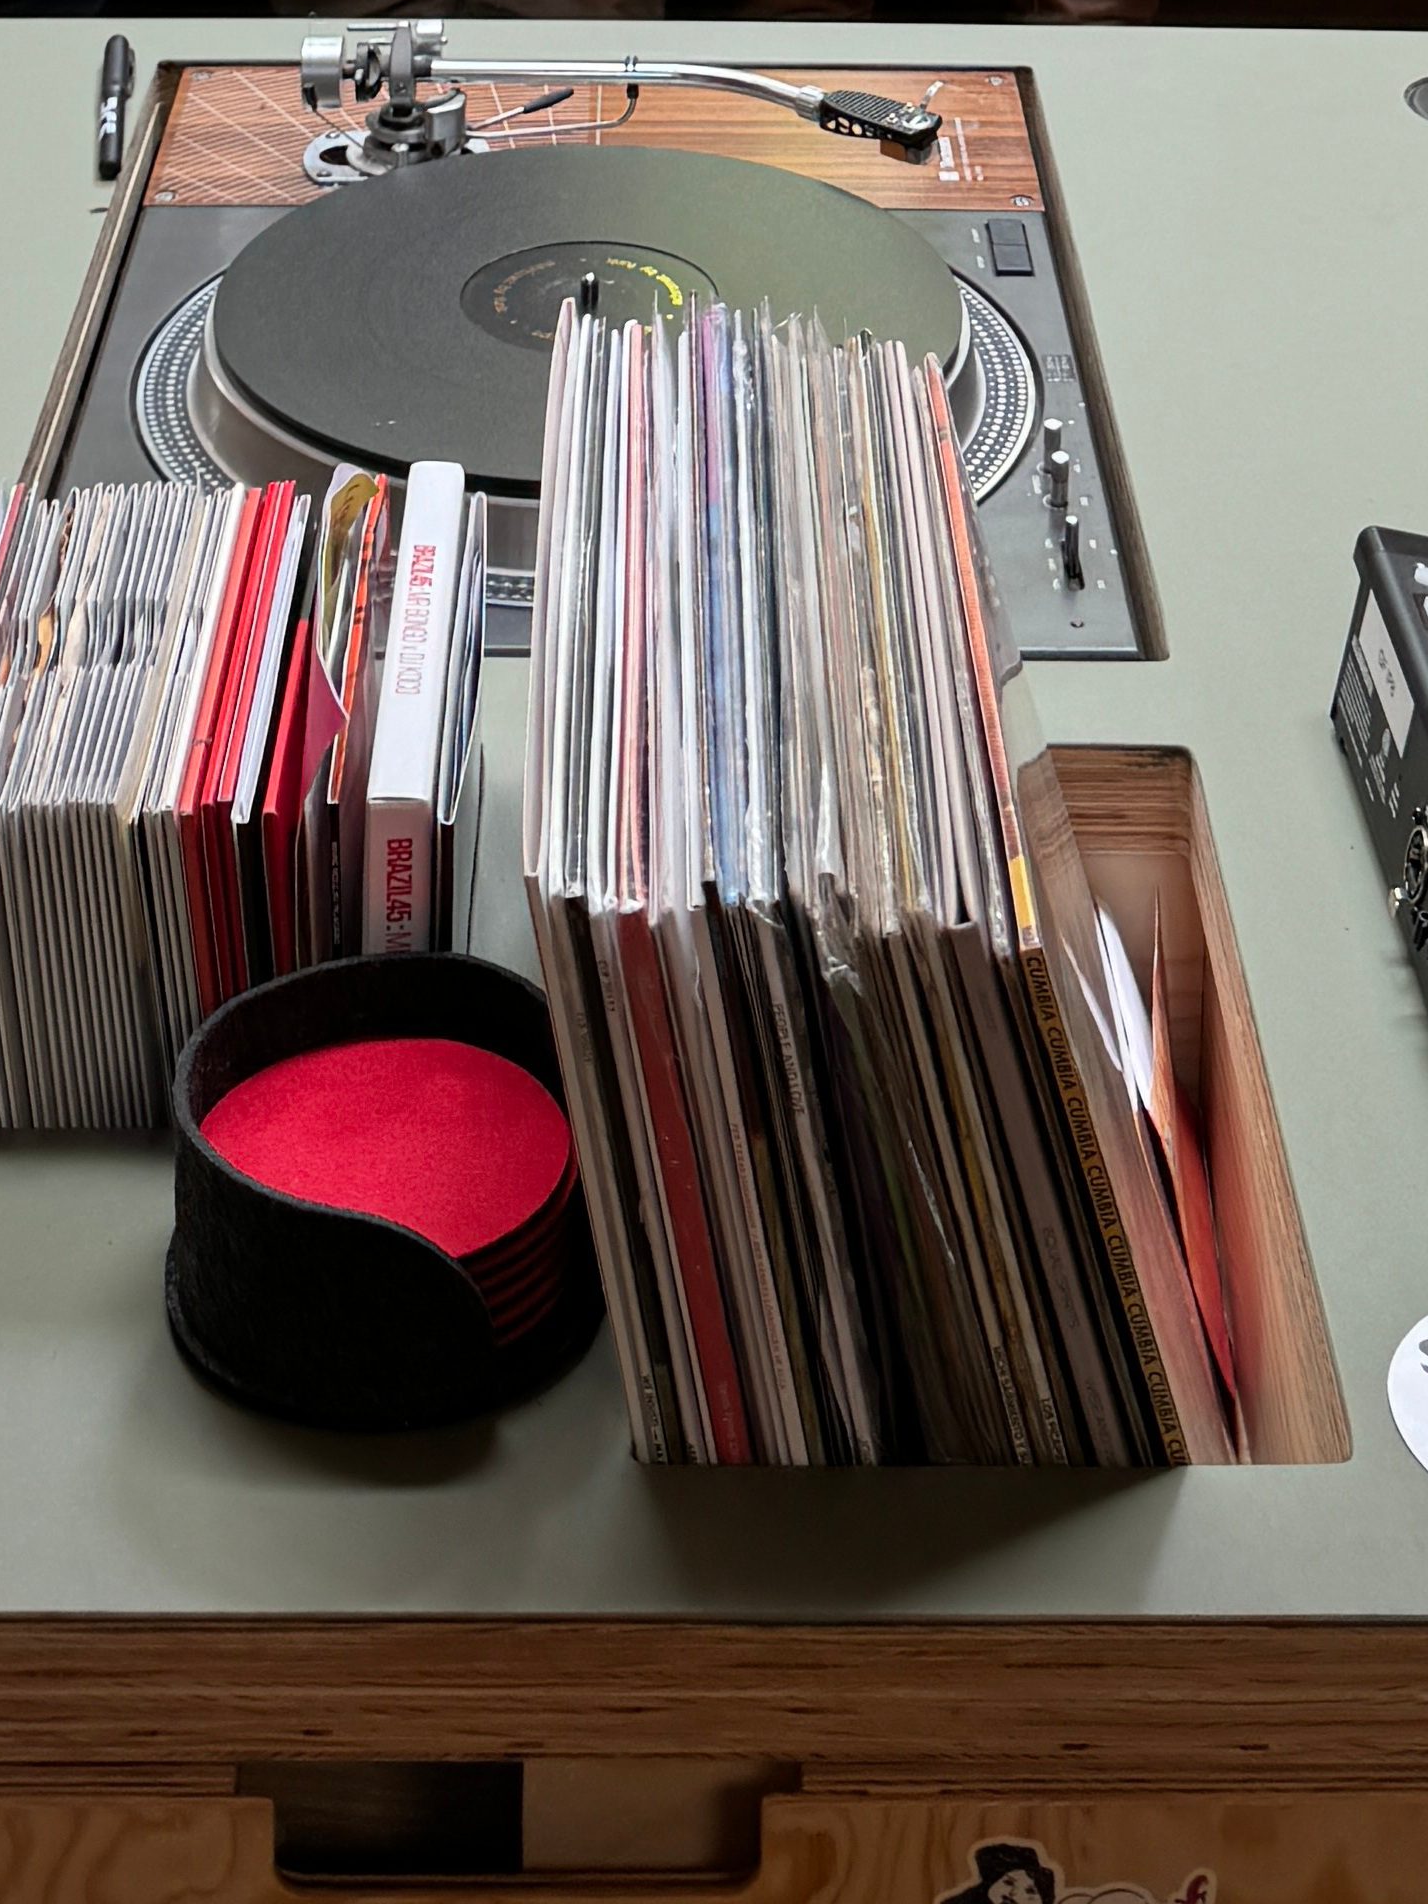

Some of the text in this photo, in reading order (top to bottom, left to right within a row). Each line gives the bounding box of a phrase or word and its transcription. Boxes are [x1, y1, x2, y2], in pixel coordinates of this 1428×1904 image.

[1026, 956, 1057, 1022] CUMBIA
[1047, 1027, 1077, 1091] CUMBIA
[1067, 1097, 1098, 1161] CUMBIA
[1086, 1165, 1118, 1229] CUMBIA
[1107, 1234, 1138, 1297] CUMBIA
[1126, 1303, 1157, 1367] CUMBIA
[1147, 1371, 1178, 1434] CUMBIA
